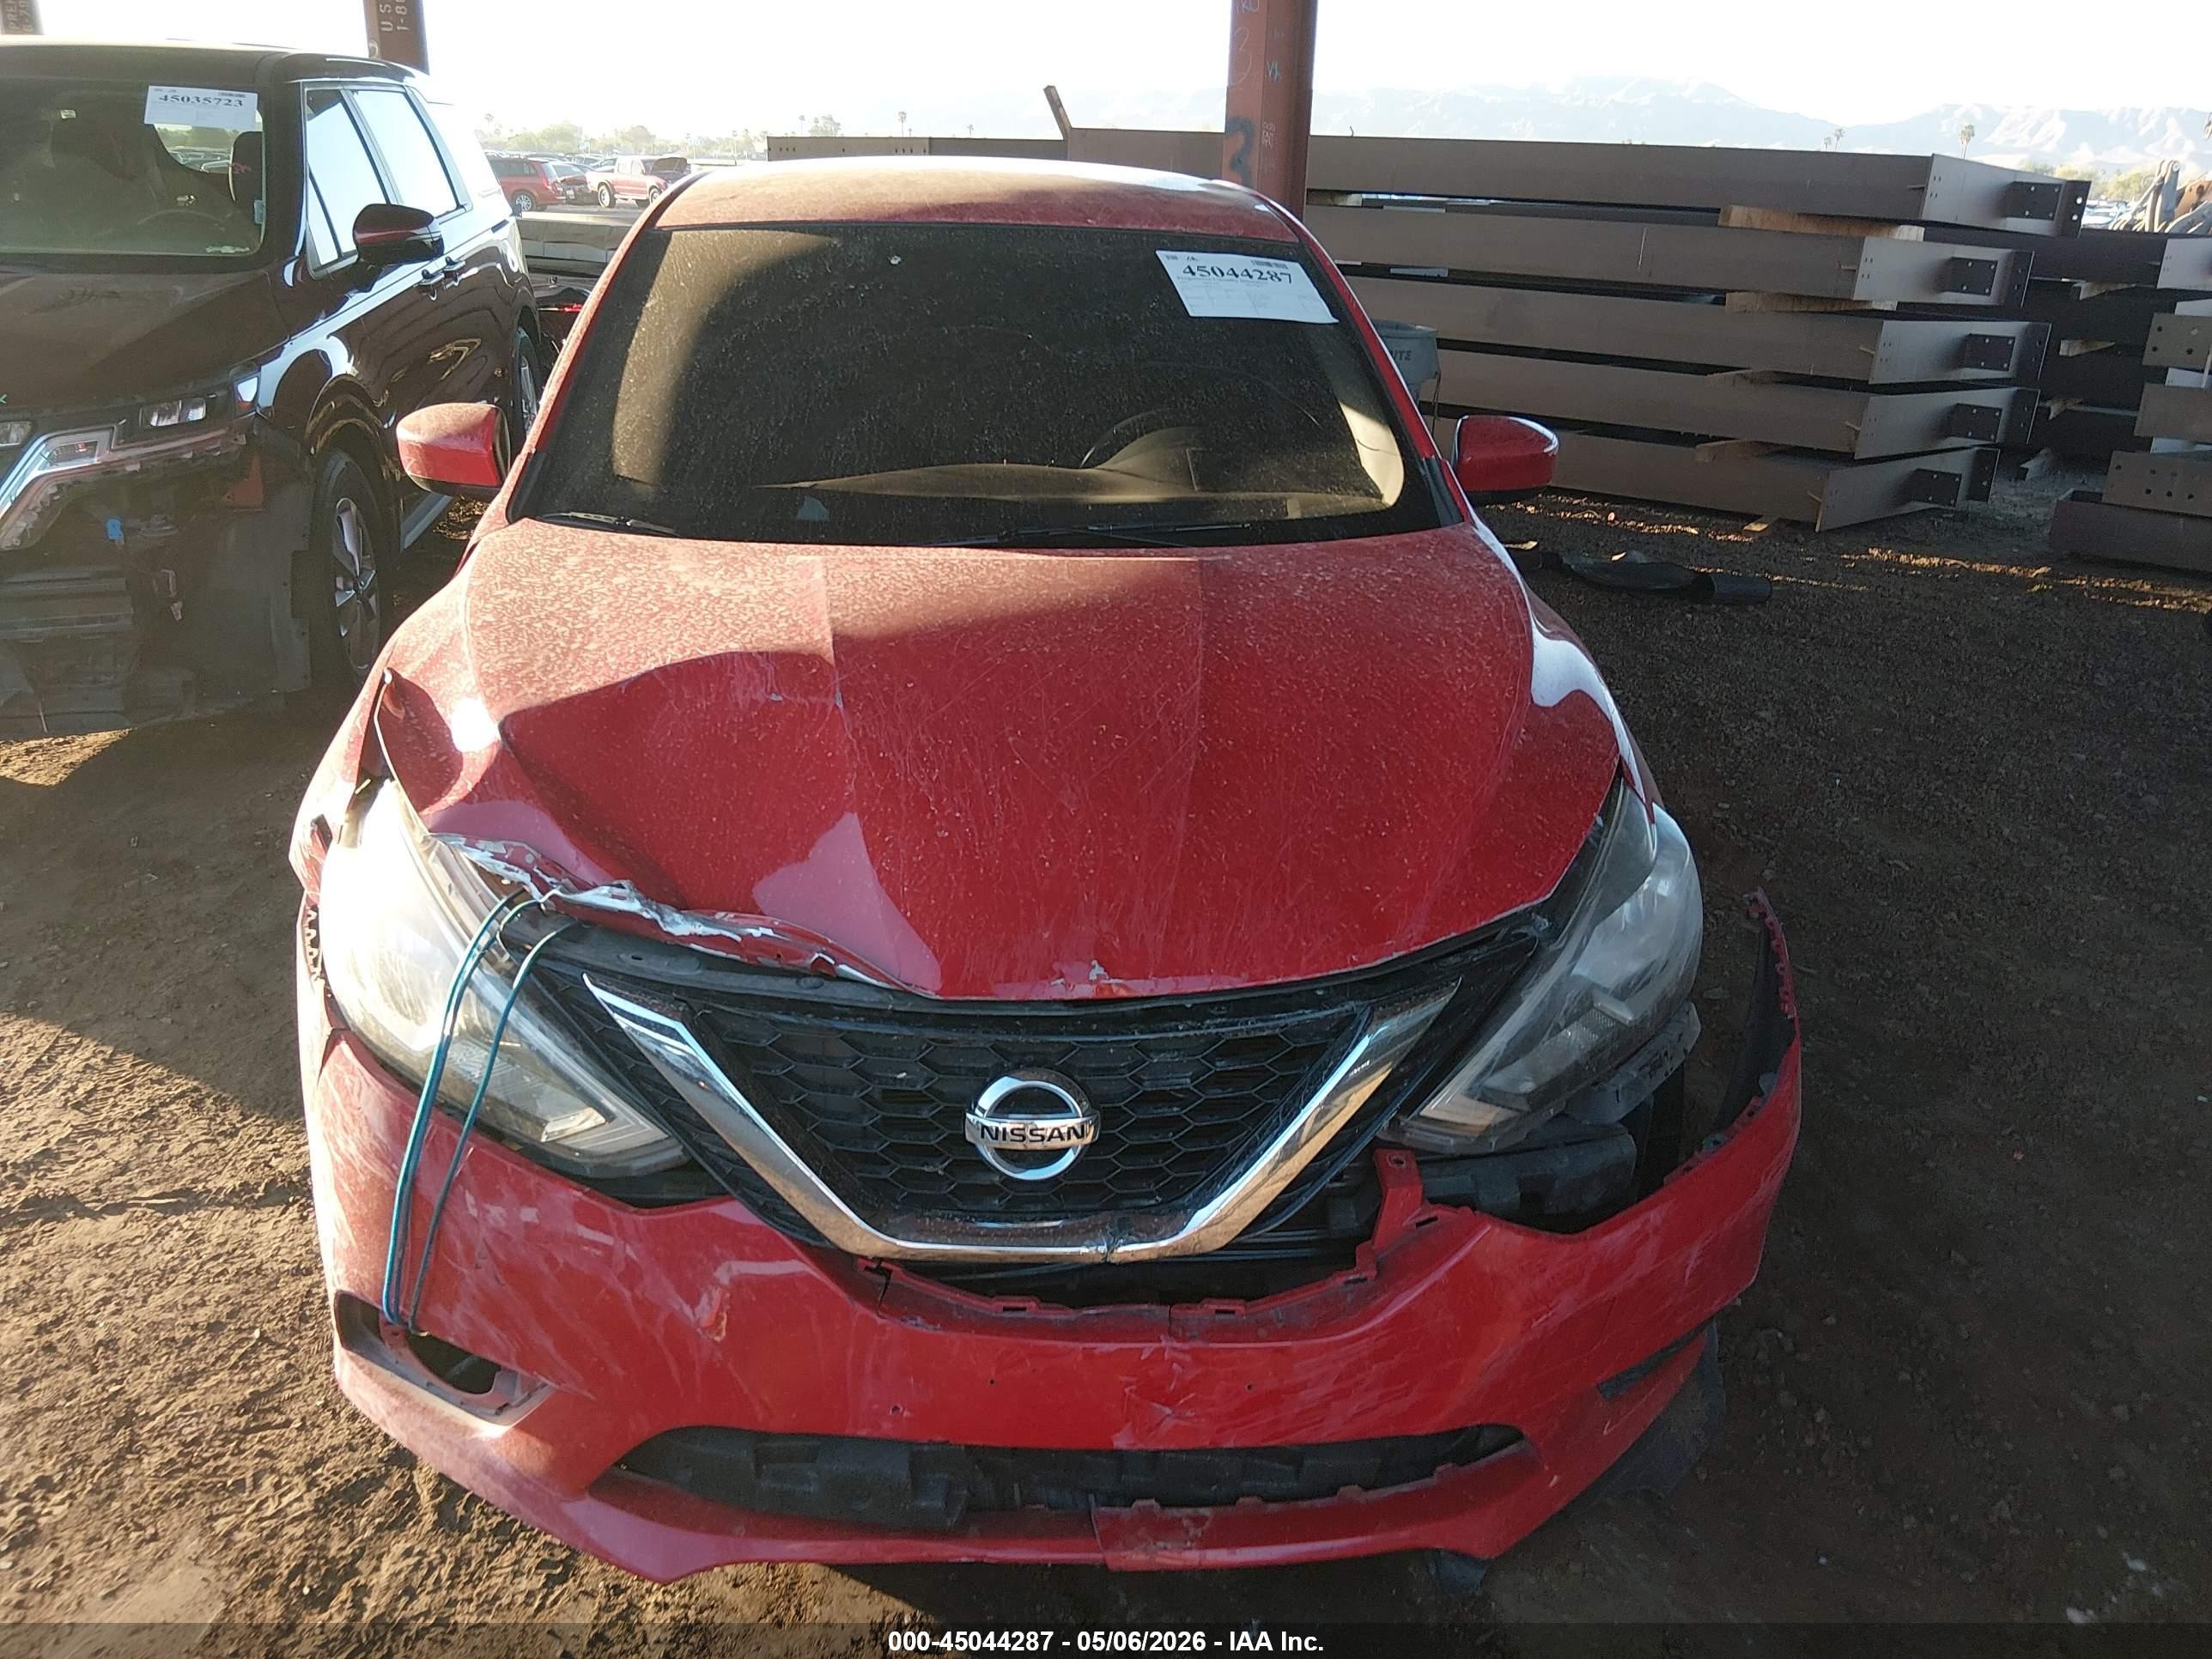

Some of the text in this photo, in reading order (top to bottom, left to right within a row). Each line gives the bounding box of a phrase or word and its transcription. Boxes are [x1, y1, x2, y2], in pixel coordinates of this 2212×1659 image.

[159, 94, 243, 107] 45035723
[1182, 264, 1292, 284] 45044287
[980, 1123, 1085, 1143] NISSAN
